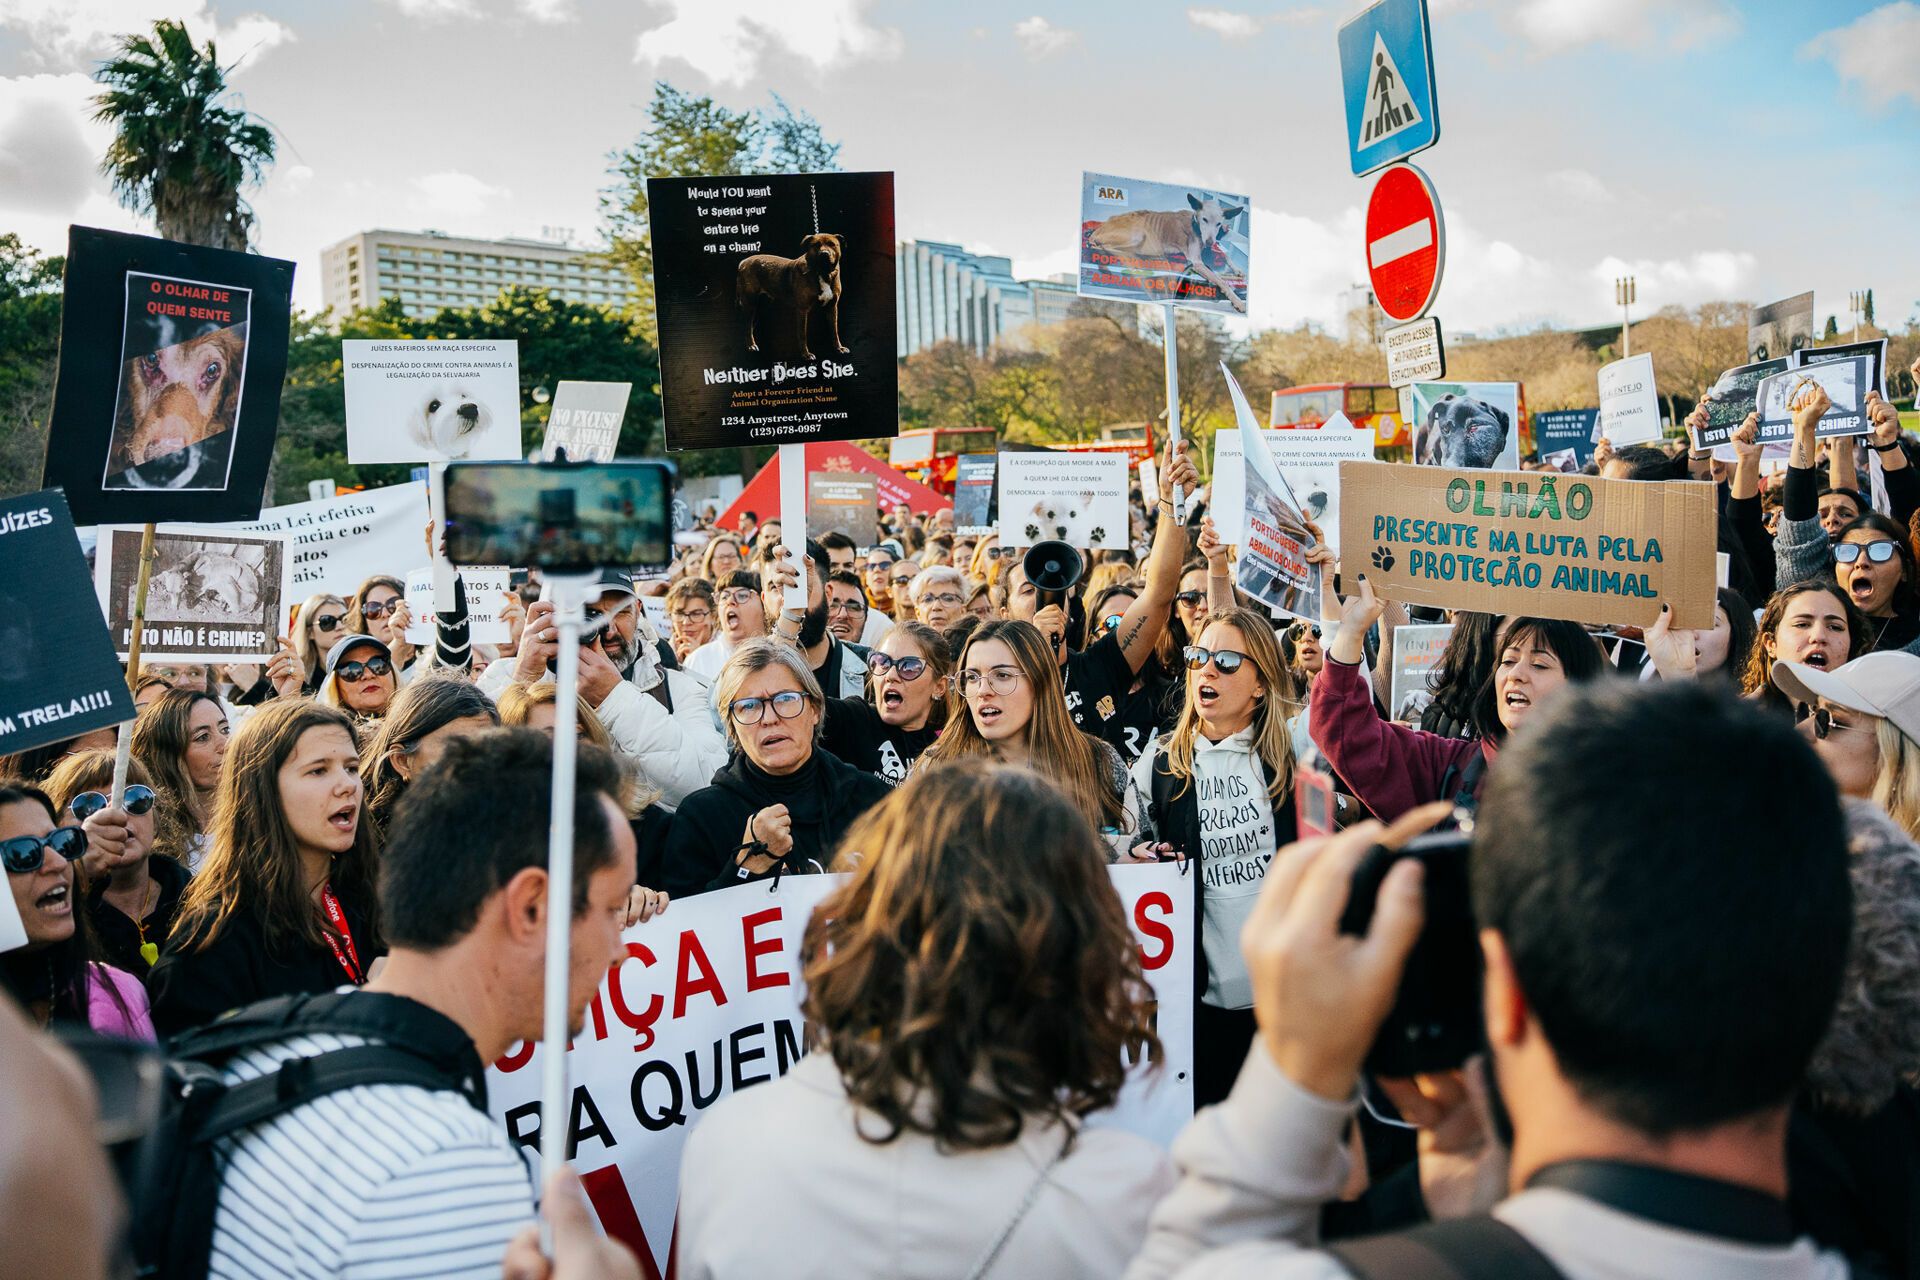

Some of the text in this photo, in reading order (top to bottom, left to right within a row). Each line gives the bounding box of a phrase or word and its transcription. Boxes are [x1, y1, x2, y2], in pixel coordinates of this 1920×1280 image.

[688, 185, 772, 200] Would YOU want
[1098, 187, 1124, 201] ARA
[697, 206, 767, 218] to spend your
[703, 223, 760, 235] entire life
[703, 241, 761, 253] on a chain?
[151, 281, 230, 303] O OLHAR DE
[1091, 272, 1142, 289] ABRAM
[1168, 279, 1217, 298] OLHOS!
[146, 301, 231, 323] QUEM SENTE
[371, 344, 393, 352] JUÍZES
[442, 345, 461, 353] RAÇA
[351, 361, 410, 370] DESPENALIZAÇÃO
[473, 361, 501, 369] ANIMAIS
[502, 360, 508, 369] É
[703, 359, 859, 385] Neither Does She.
[386, 371, 431, 380] LEGALIZAÇÃO
[732, 391, 757, 399] Adopt
[764, 389, 795, 397] Forever
[797, 387, 824, 395] Friend
[730, 400, 759, 408] Animal
[761, 397, 814, 407] Organization
[552, 408, 620, 430] NO EXCUSE
[721, 411, 848, 427] 1234 Anystreet, Anytown
[1616, 406, 1643, 418] ANIMAIS
[1818, 416, 1861, 431] CRIME?
[1704, 429, 1726, 442] ISTO
[1761, 426, 1786, 438] ISTO
[1020, 459, 1057, 467] CORRUPÇÃO
[1446, 476, 1593, 521] OLHÃO
[286, 512, 316, 529] Lei
[318, 504, 376, 523] efetiva
[339, 527, 348, 538] e
[352, 523, 371, 536] os
[1250, 517, 1300, 555] PORTUGUESES
[1373, 515, 1664, 563] PRESENTE NA LUTA PELA
[1247, 554, 1257, 566] Eles
[1248, 537, 1308, 579] ABRAM OS OLHOS!
[1409, 549, 1659, 598] PROTEÇÃO ANIMAL
[495, 582, 502, 591] A
[422, 612, 428, 623] É
[123, 626, 266, 648] ITO NÃO É CRIME?
[18, 690, 113, 729] TRELA!!!!
[741, 907, 791, 993] E
